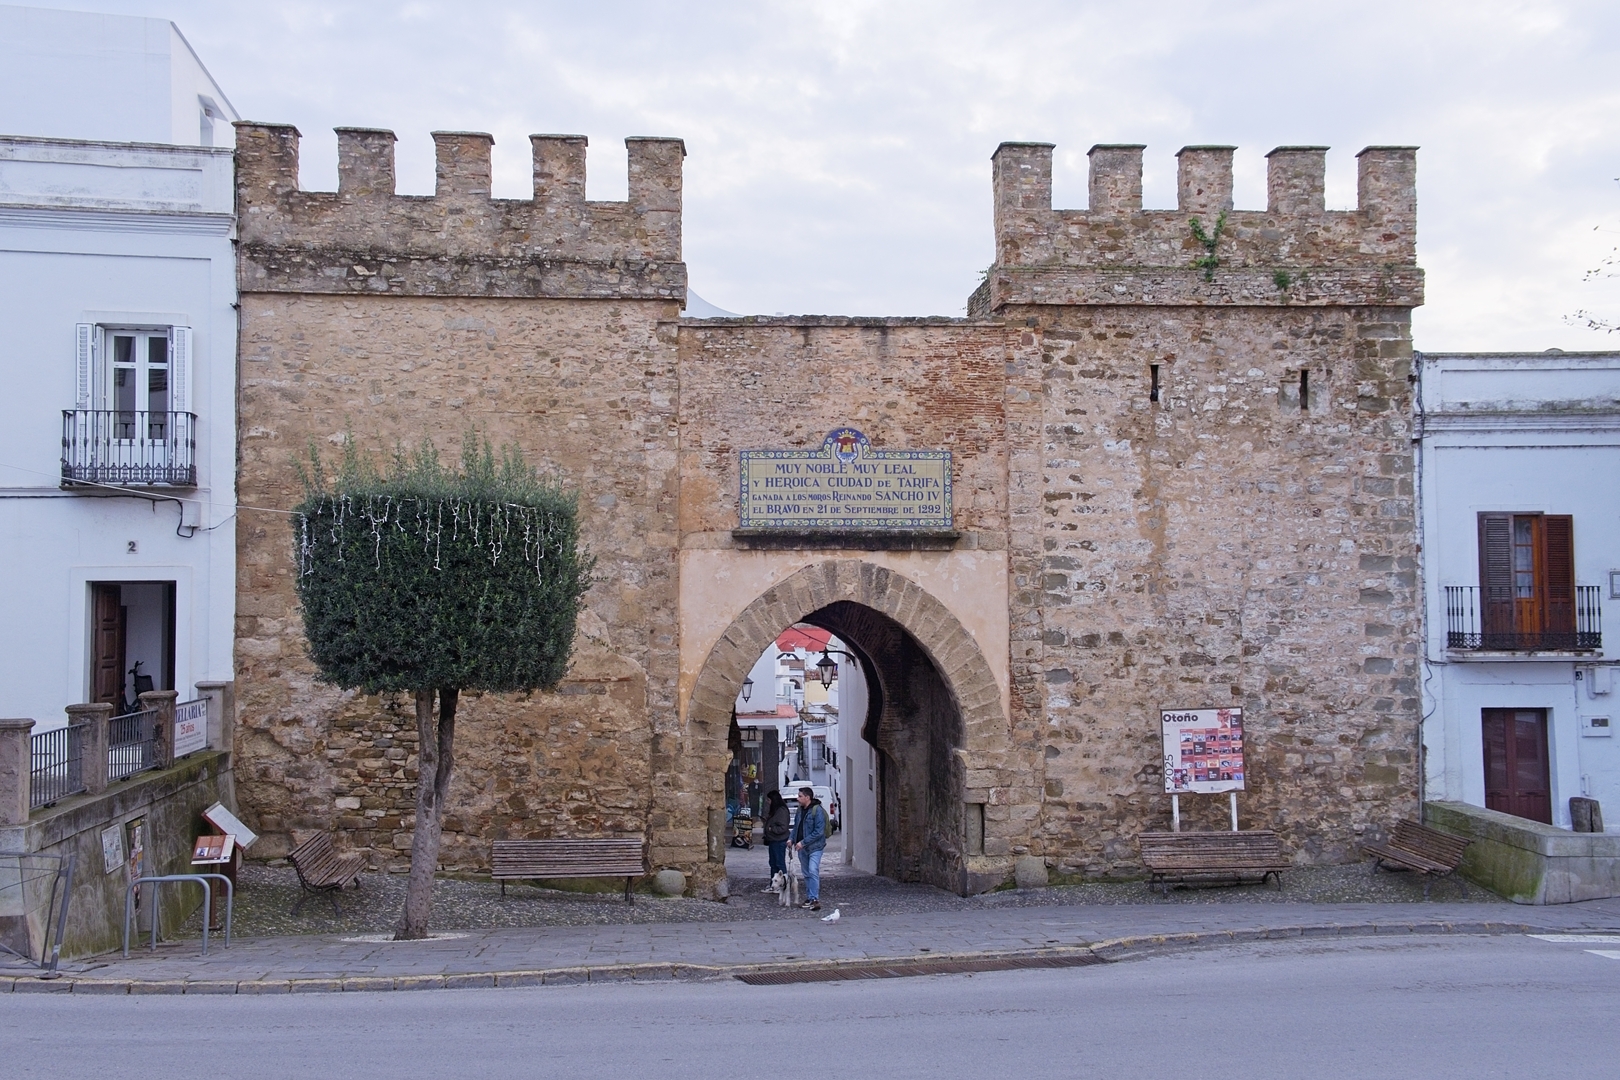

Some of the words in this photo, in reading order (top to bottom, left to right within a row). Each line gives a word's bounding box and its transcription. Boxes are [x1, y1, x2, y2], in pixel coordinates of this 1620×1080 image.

[775, 464, 801, 474] MUY
[806, 464, 847, 474] NOBLE
[853, 462, 880, 474] MUY
[884, 464, 916, 474] LEAL
[765, 477, 820, 489] HEROICA
[827, 477, 873, 488] CIUDAD
[877, 480, 892, 488] DE
[897, 477, 940, 489] TARIFA
[808, 494, 832, 502] MOROS
[875, 491, 924, 501] SANCHO
[927, 491, 940, 501] IV
[753, 506, 764, 514] EL
[766, 504, 800, 515] BRAVO
[802, 506, 814, 514] EN
[817, 504, 827, 514] 21
[830, 506, 842, 514] DE
[918, 504, 941, 514] 1292
[128, 541, 136, 552] 2
[1163, 712, 1198, 722] Otoño
[1164, 754, 1174, 783] 2025
